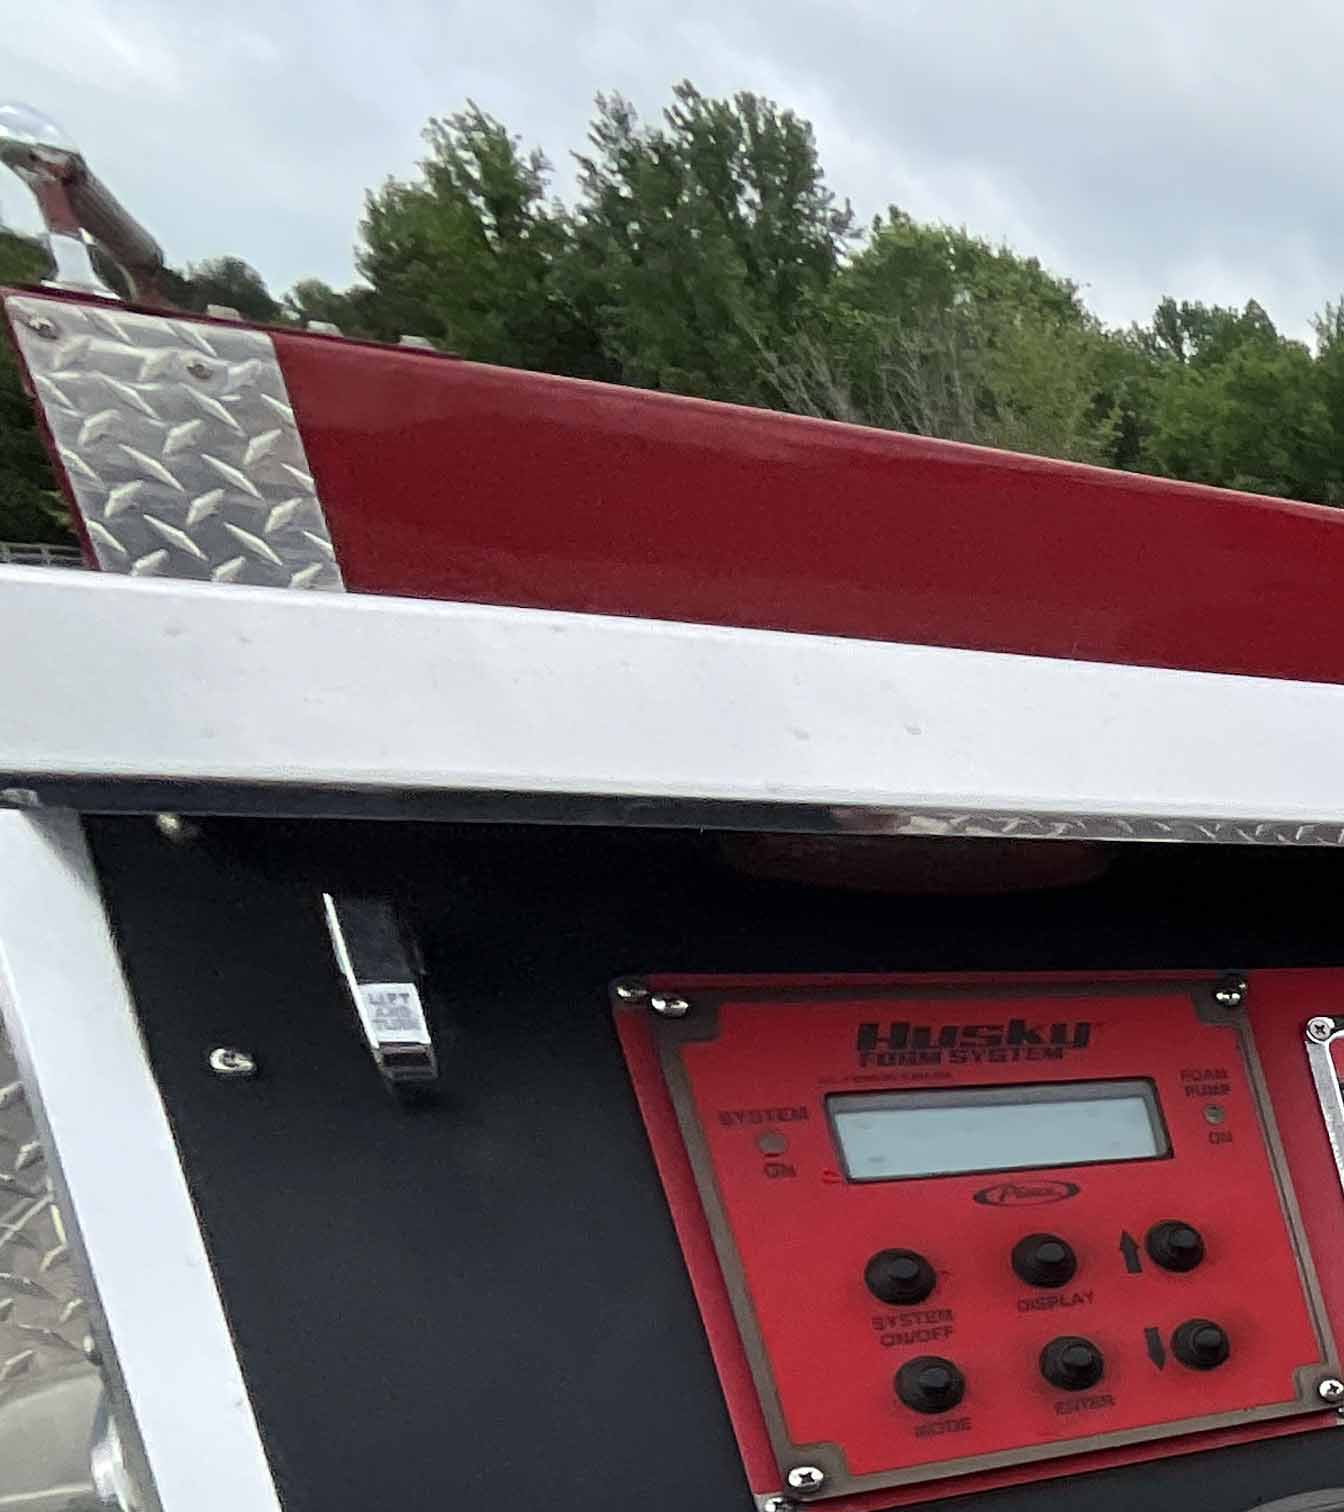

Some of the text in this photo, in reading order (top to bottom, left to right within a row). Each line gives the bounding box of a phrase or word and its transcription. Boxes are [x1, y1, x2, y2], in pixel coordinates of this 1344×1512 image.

[857, 1019, 1092, 1051] Husky
[948, 1047, 1065, 1064] SYSTEM
[719, 1104, 809, 1126] SYSTEM
[1016, 1290, 1094, 1312] DISPLAY
[871, 1308, 954, 1330] SYSTEM
